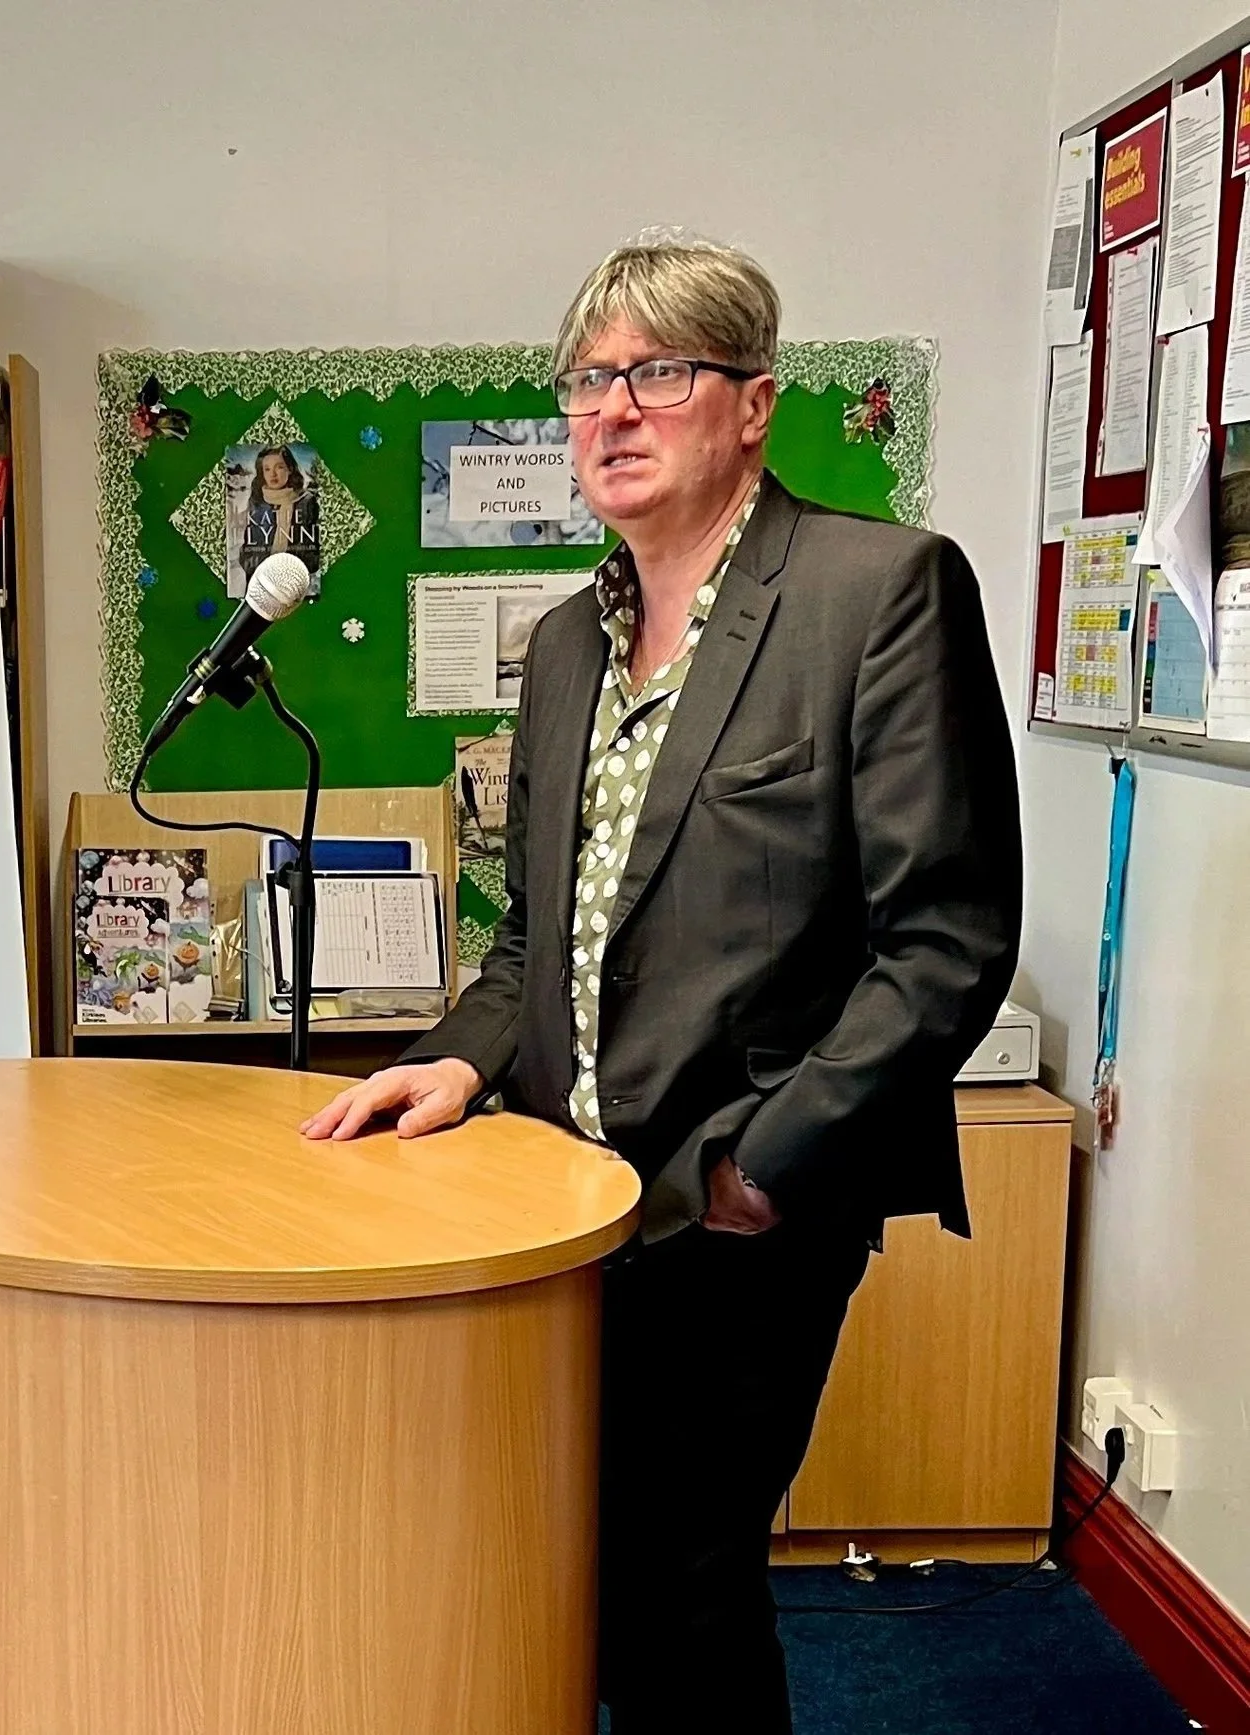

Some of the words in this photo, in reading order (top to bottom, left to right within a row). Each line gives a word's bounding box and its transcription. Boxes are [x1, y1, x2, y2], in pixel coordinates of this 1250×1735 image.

[459, 454, 510, 466] WINTRY
[515, 453, 564, 466] WORDS
[496, 477, 526, 490] AND
[480, 501, 542, 513] PICTURES
[248, 509, 303, 526] KATIE
[108, 875, 171, 893] Library
[96, 913, 140, 928] Library
